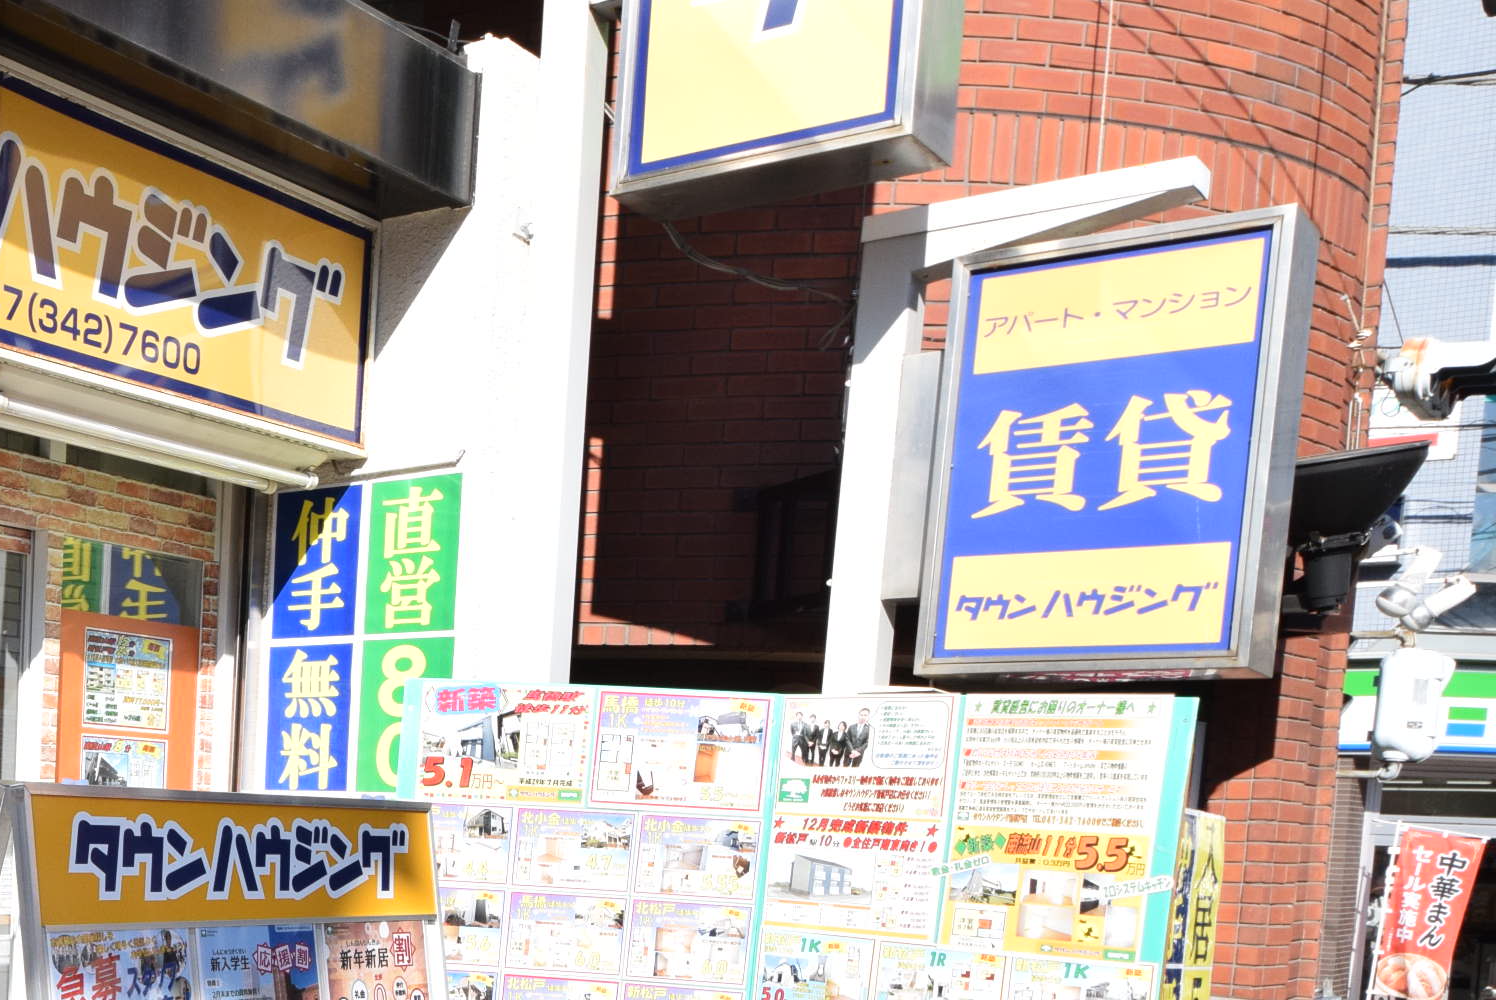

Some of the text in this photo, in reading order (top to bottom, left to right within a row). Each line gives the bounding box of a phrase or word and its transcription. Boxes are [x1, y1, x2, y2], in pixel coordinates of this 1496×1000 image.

[983, 284, 1253, 339] アパート・マンション
[971, 388, 1232, 519] 賃貸
[955, 580, 1220, 621] タウンハウジング
[437, 687, 497, 713] 新築
[603, 695, 640, 714] 馬橋
[520, 812, 560, 827] 北小金
[643, 818, 684, 833] 北小金
[802, 817, 909, 837] 12月完成新築物件
[70, 812, 408, 899] タウンハウジング
[1395, 844, 1434, 944] セール実施中
[1418, 851, 1468, 949] 中華まん
[393, 934, 412, 965] 割
[800, 937, 822, 954] 1K
[210, 954, 251, 973] 新入学生
[339, 947, 389, 971] 新年新居
[929, 951, 947, 967] 1R
[1063, 962, 1090, 980] 1K
[354, 989, 366, 1000] 礼金
[506, 977, 546, 992] 北松戸
